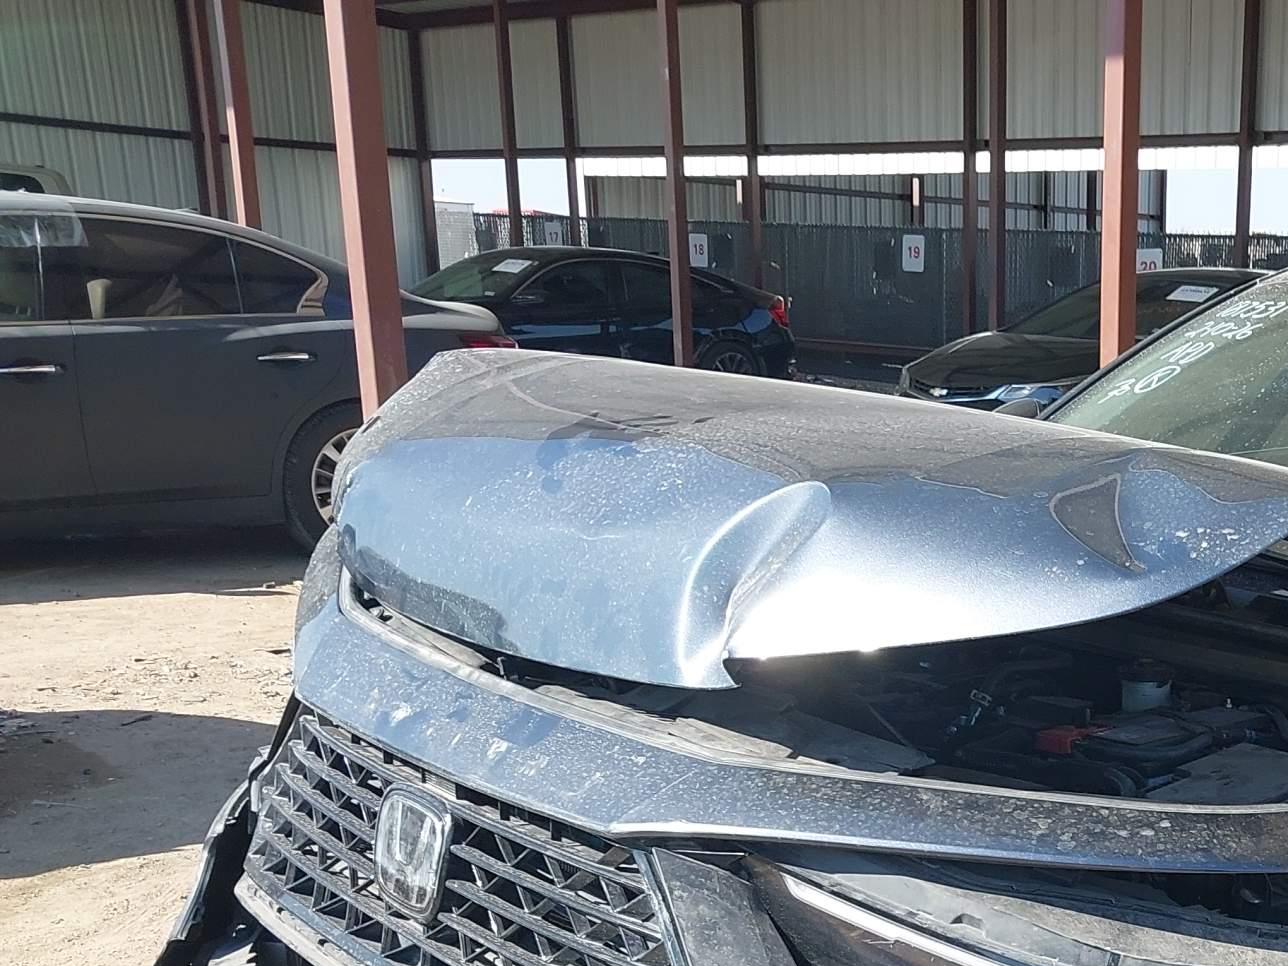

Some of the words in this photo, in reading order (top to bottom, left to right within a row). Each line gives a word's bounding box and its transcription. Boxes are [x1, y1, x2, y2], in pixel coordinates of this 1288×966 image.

[549, 231, 559, 243] 17
[693, 243, 704, 256] 18
[908, 245, 920, 259] 19
